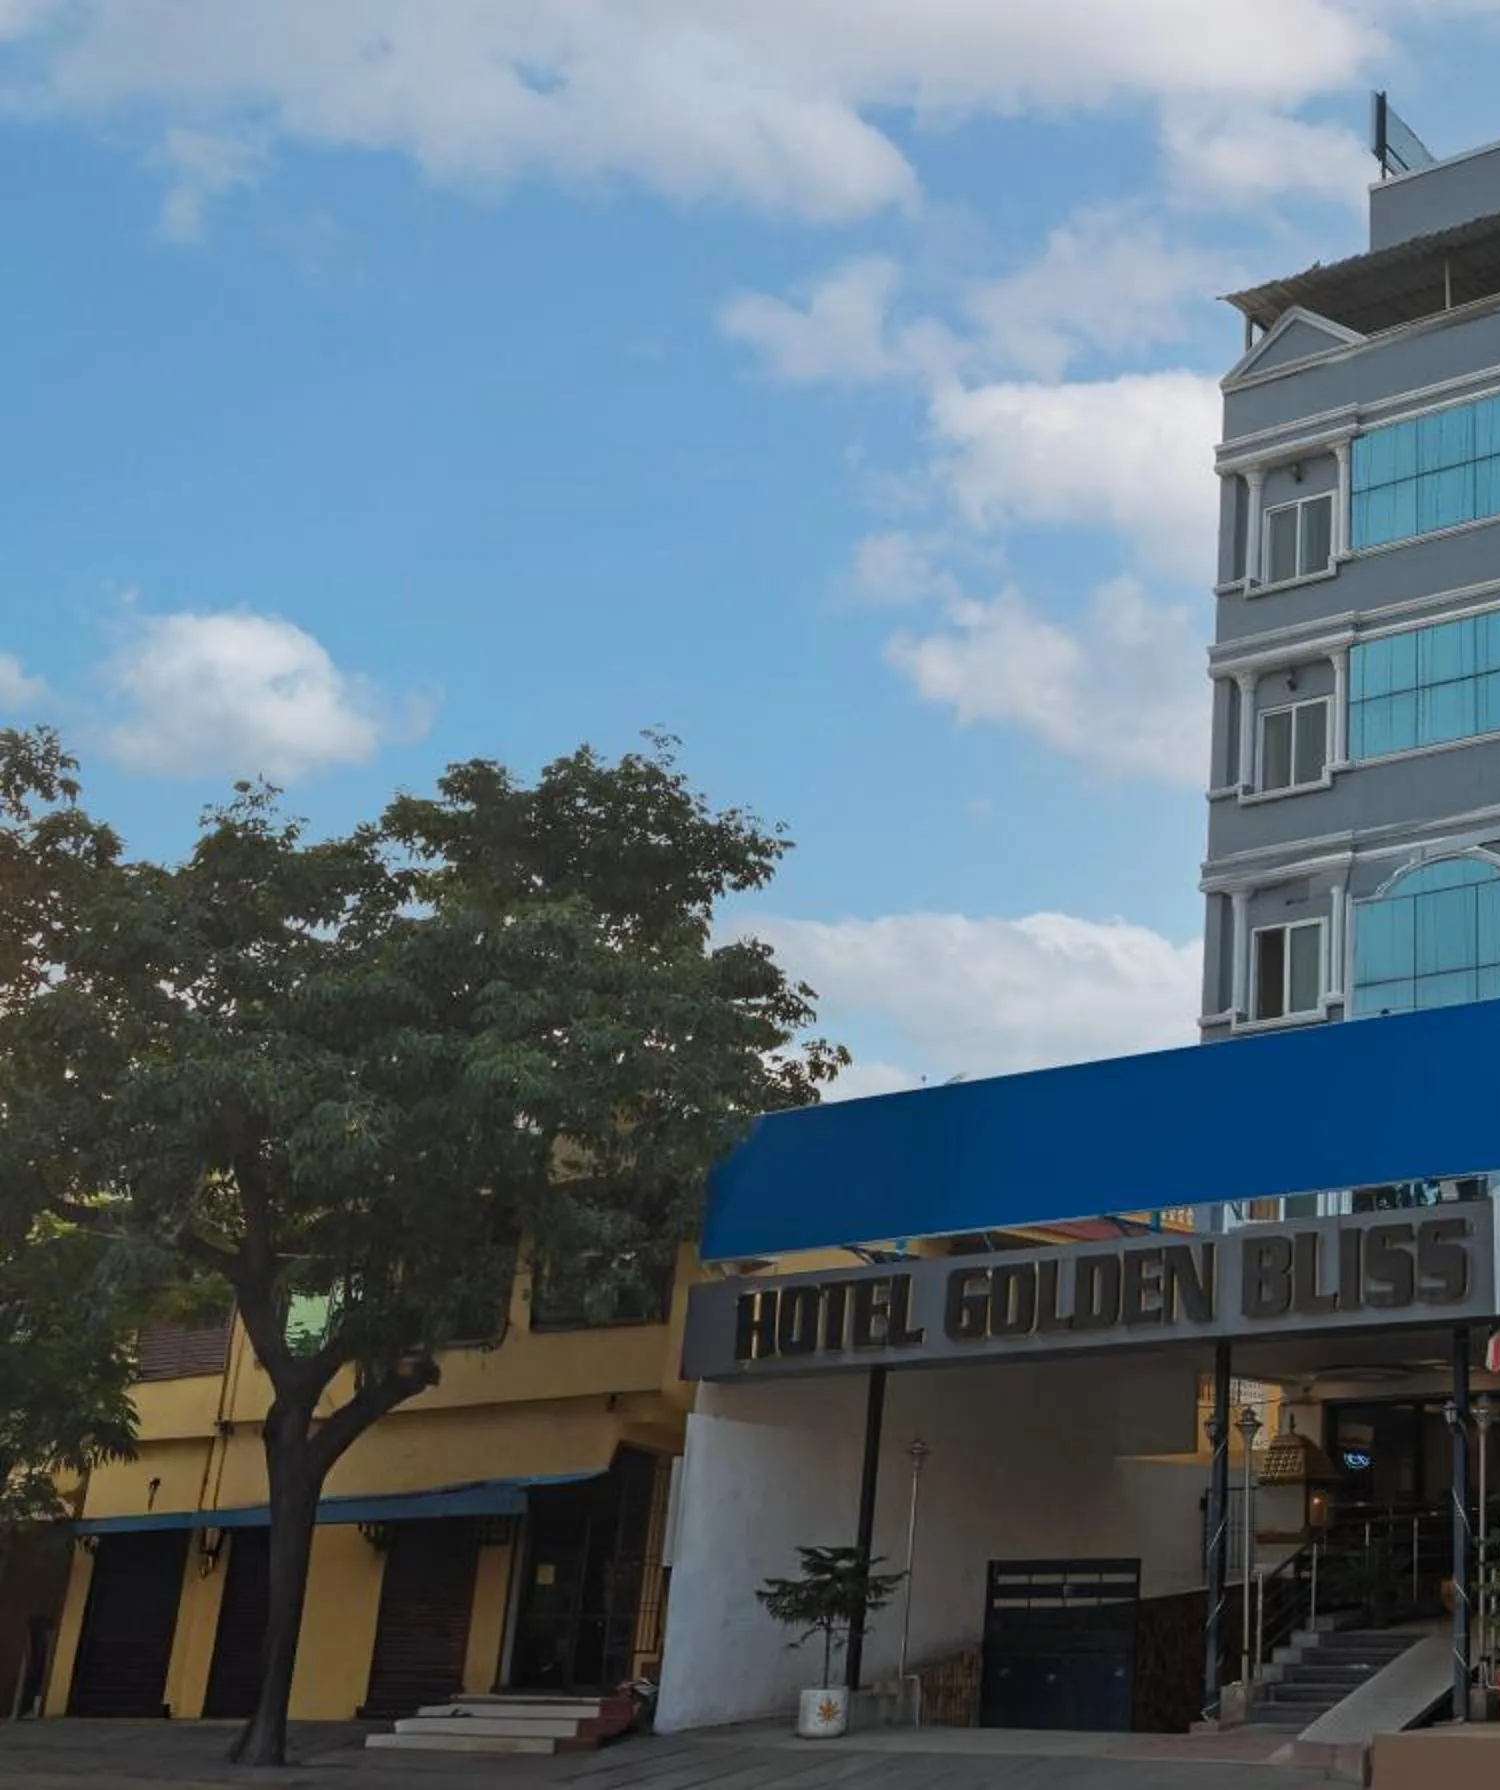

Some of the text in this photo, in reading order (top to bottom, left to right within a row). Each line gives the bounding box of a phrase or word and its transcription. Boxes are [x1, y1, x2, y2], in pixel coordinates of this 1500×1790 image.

[736, 1218, 1468, 1361] HOTEL GOLDEN BLISS
